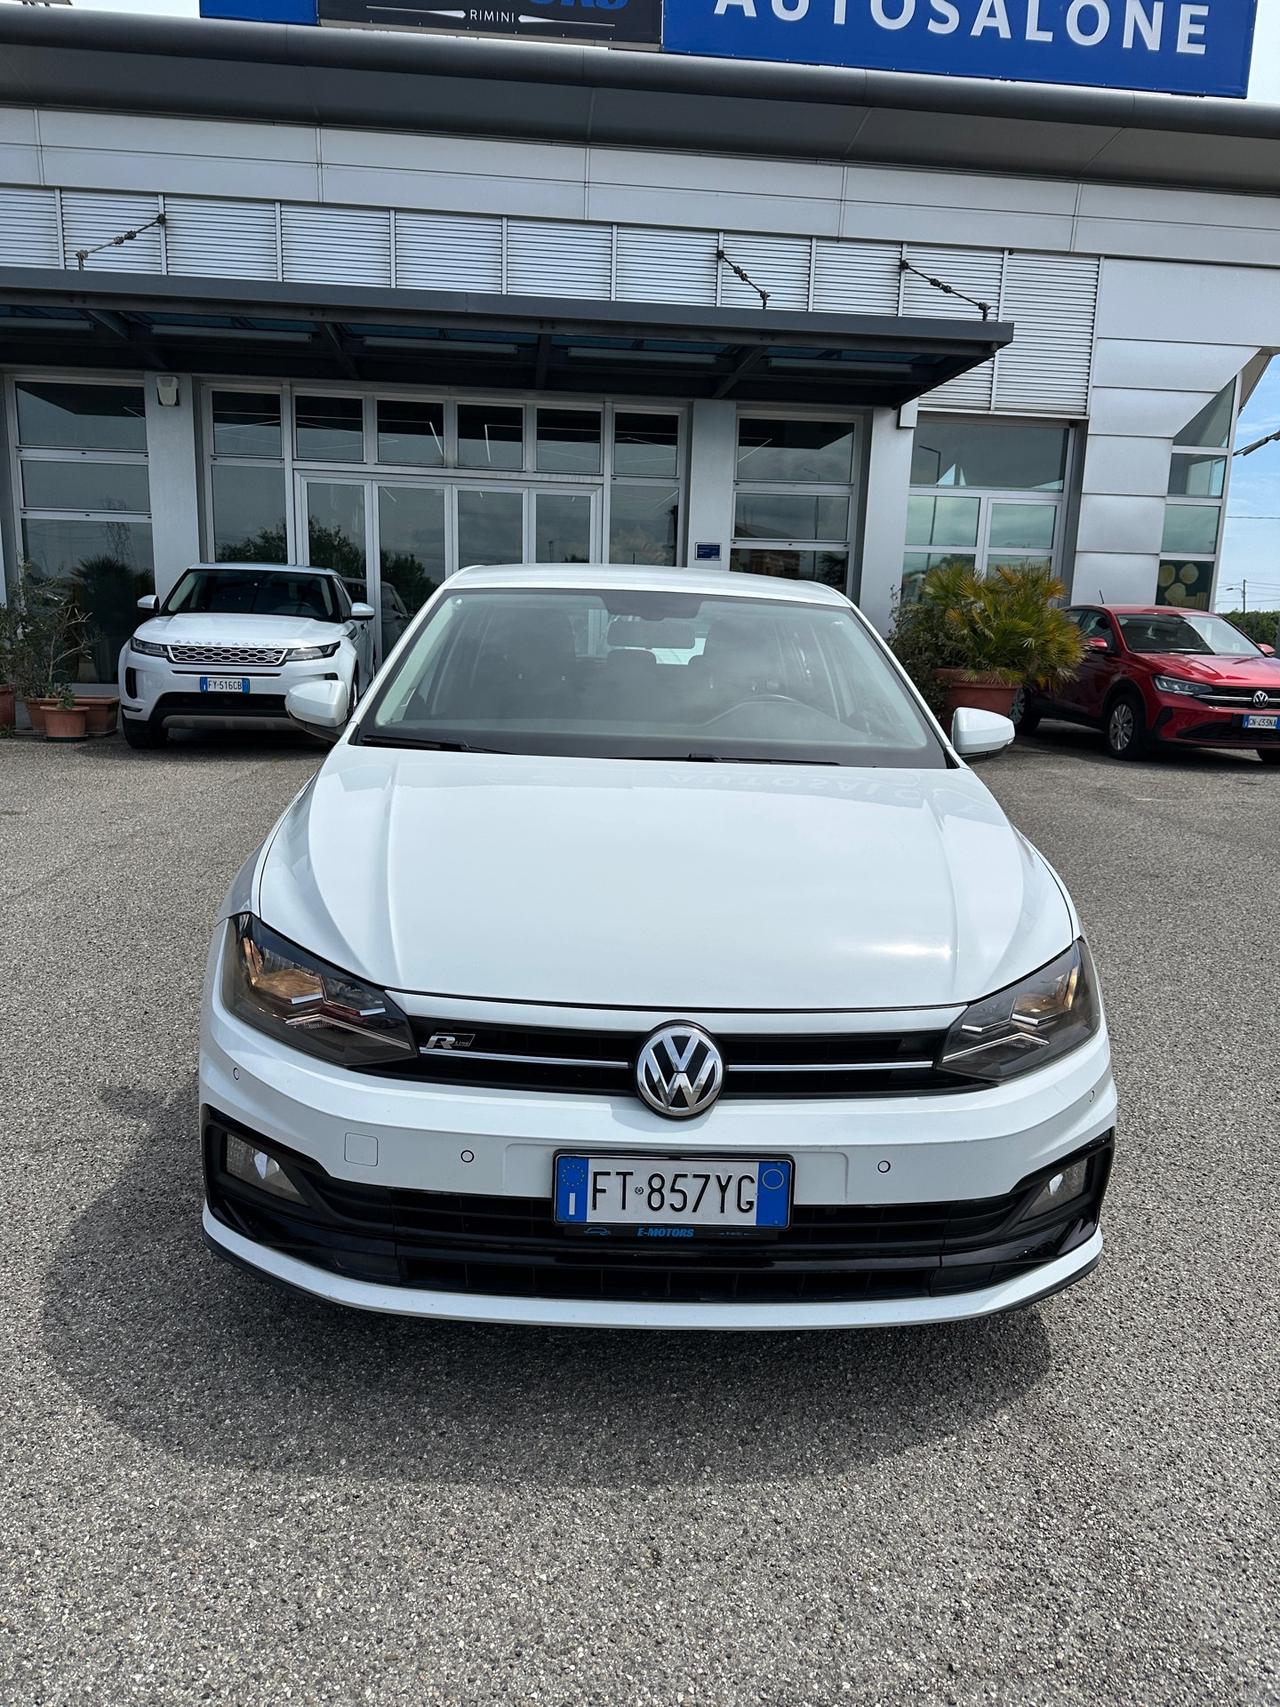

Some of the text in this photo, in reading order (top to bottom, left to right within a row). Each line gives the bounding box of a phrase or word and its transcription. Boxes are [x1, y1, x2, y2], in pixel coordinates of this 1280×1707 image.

[469, 9, 515, 23] RIMINI
[591, 1171, 756, 1214] FT 857YG
[636, 1227, 695, 1238] E-MOTORS
